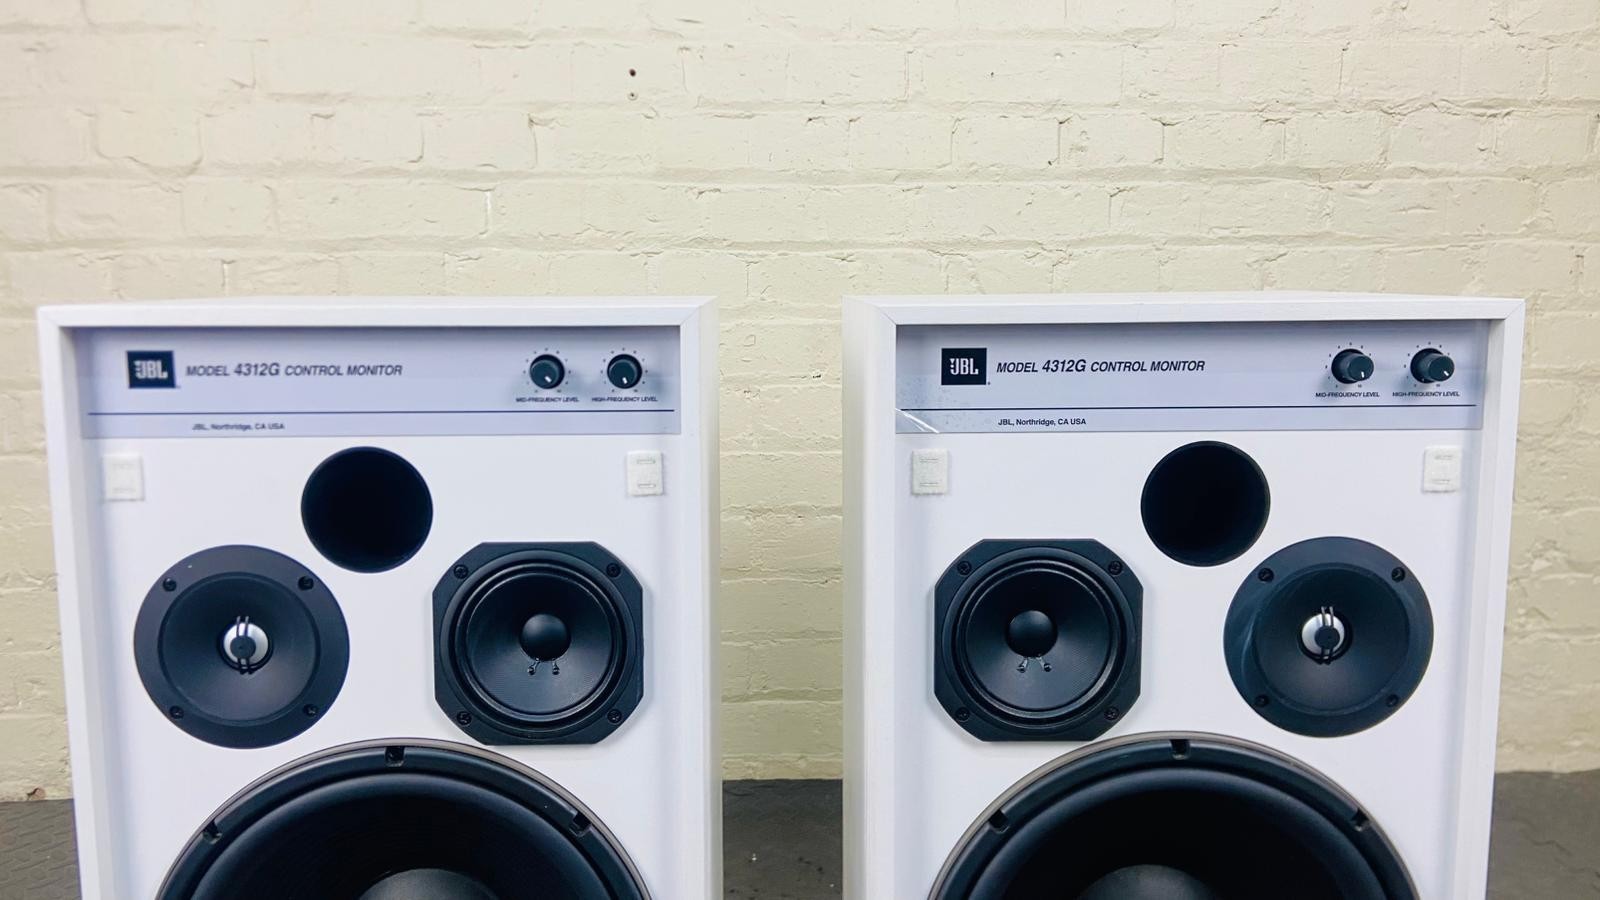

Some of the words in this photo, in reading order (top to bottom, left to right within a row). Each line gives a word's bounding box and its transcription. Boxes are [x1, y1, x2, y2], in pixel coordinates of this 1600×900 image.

[134, 360, 168, 379] JBL
[186, 365, 230, 376] MODEL
[234, 362, 280, 376] 4312G
[285, 365, 343, 376] CONTROL
[347, 365, 402, 376] MONITOR
[949, 358, 979, 375] JBL
[996, 362, 1038, 373] MODEL
[1042, 359, 1087, 373] 4312G
[1090, 361, 1147, 372] CONTROL
[1150, 360, 1205, 372] MONITOR
[211, 423, 253, 431] Northridge,
[998, 418, 1014, 426] JBL,
[1016, 418, 1056, 427] Northridge,
